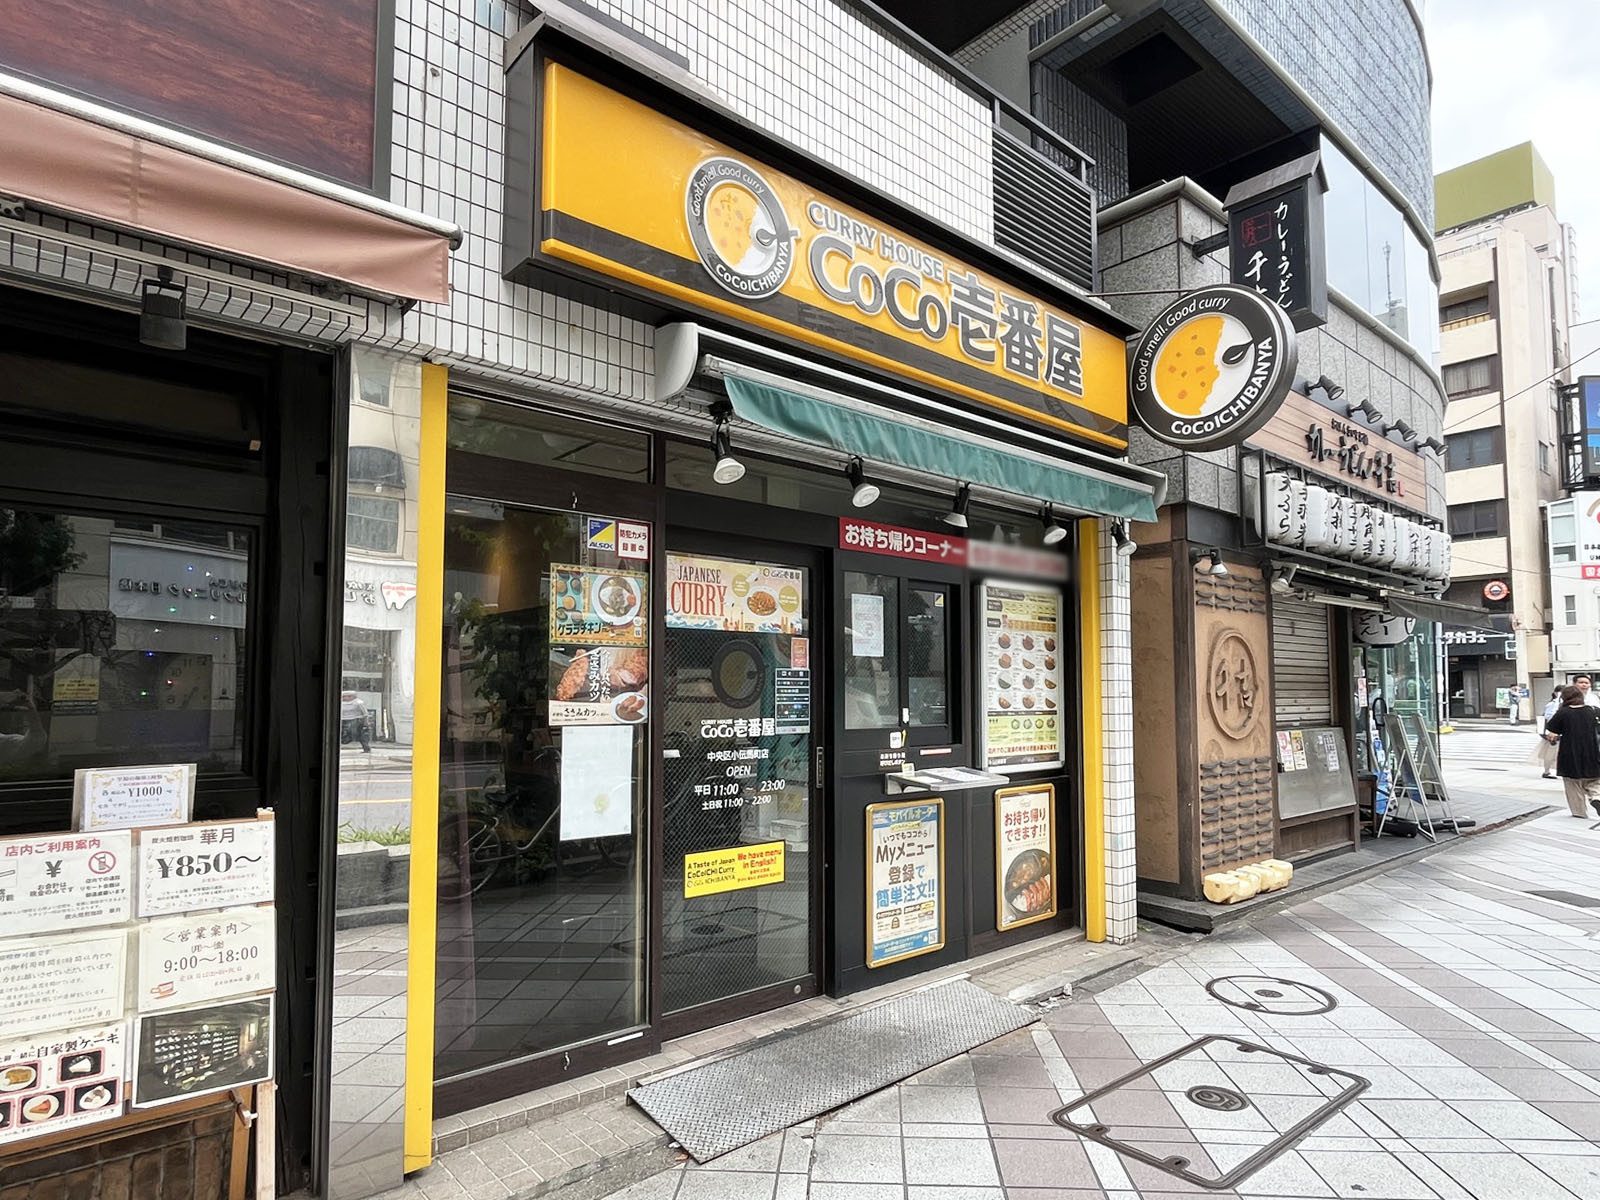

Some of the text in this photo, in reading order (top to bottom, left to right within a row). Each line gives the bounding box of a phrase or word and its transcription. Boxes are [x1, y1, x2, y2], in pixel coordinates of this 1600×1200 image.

[718, 164, 741, 178] Good
[743, 173, 765, 195] curry
[808, 200, 945, 283] CURRY HOUSE
[1274, 201, 1293, 309] カレーうどん
[716, 241, 789, 292] CoCoICHIBANYA
[808, 235, 1085, 397] CoCo壱番屋
[1136, 296, 1231, 391] Good smell. Good curry
[1170, 337, 1273, 436] CoCoICHIBANYA
[620, 529, 647, 540] 防犯カメラ
[844, 523, 965, 558] お持ち帰りコーナー
[589, 541, 613, 550] ALSOK
[678, 565, 722, 584] JAPANESE
[670, 581, 728, 616] CURRY
[701, 718, 775, 738] CoCo壱番屋
[726, 766, 752, 777] OPEN
[128, 786, 164, 798] ¥1000
[694, 784, 711, 796] 平日
[713, 783, 739, 796] 11:00
[760, 779, 786, 792] 23:00
[702, 800, 722, 810] 土日祝
[724, 797, 744, 808] 11:00
[752, 795, 772, 806] 22:00
[1004, 808, 1046, 826] お持ち帰り
[200, 828, 236, 846] 華月
[1004, 824, 1047, 842] できます!!
[5, 838, 101, 857] 店内ご利用案内
[748, 852, 764, 860] have
[764, 848, 782, 858] menu
[876, 841, 935, 866] Myメニュー
[693, 861, 710, 869] Taste
[888, 864, 926, 886] 登録で
[876, 879, 936, 910] 簡単注文!!
[37, 1032, 119, 1058] 自家製ケーキ
